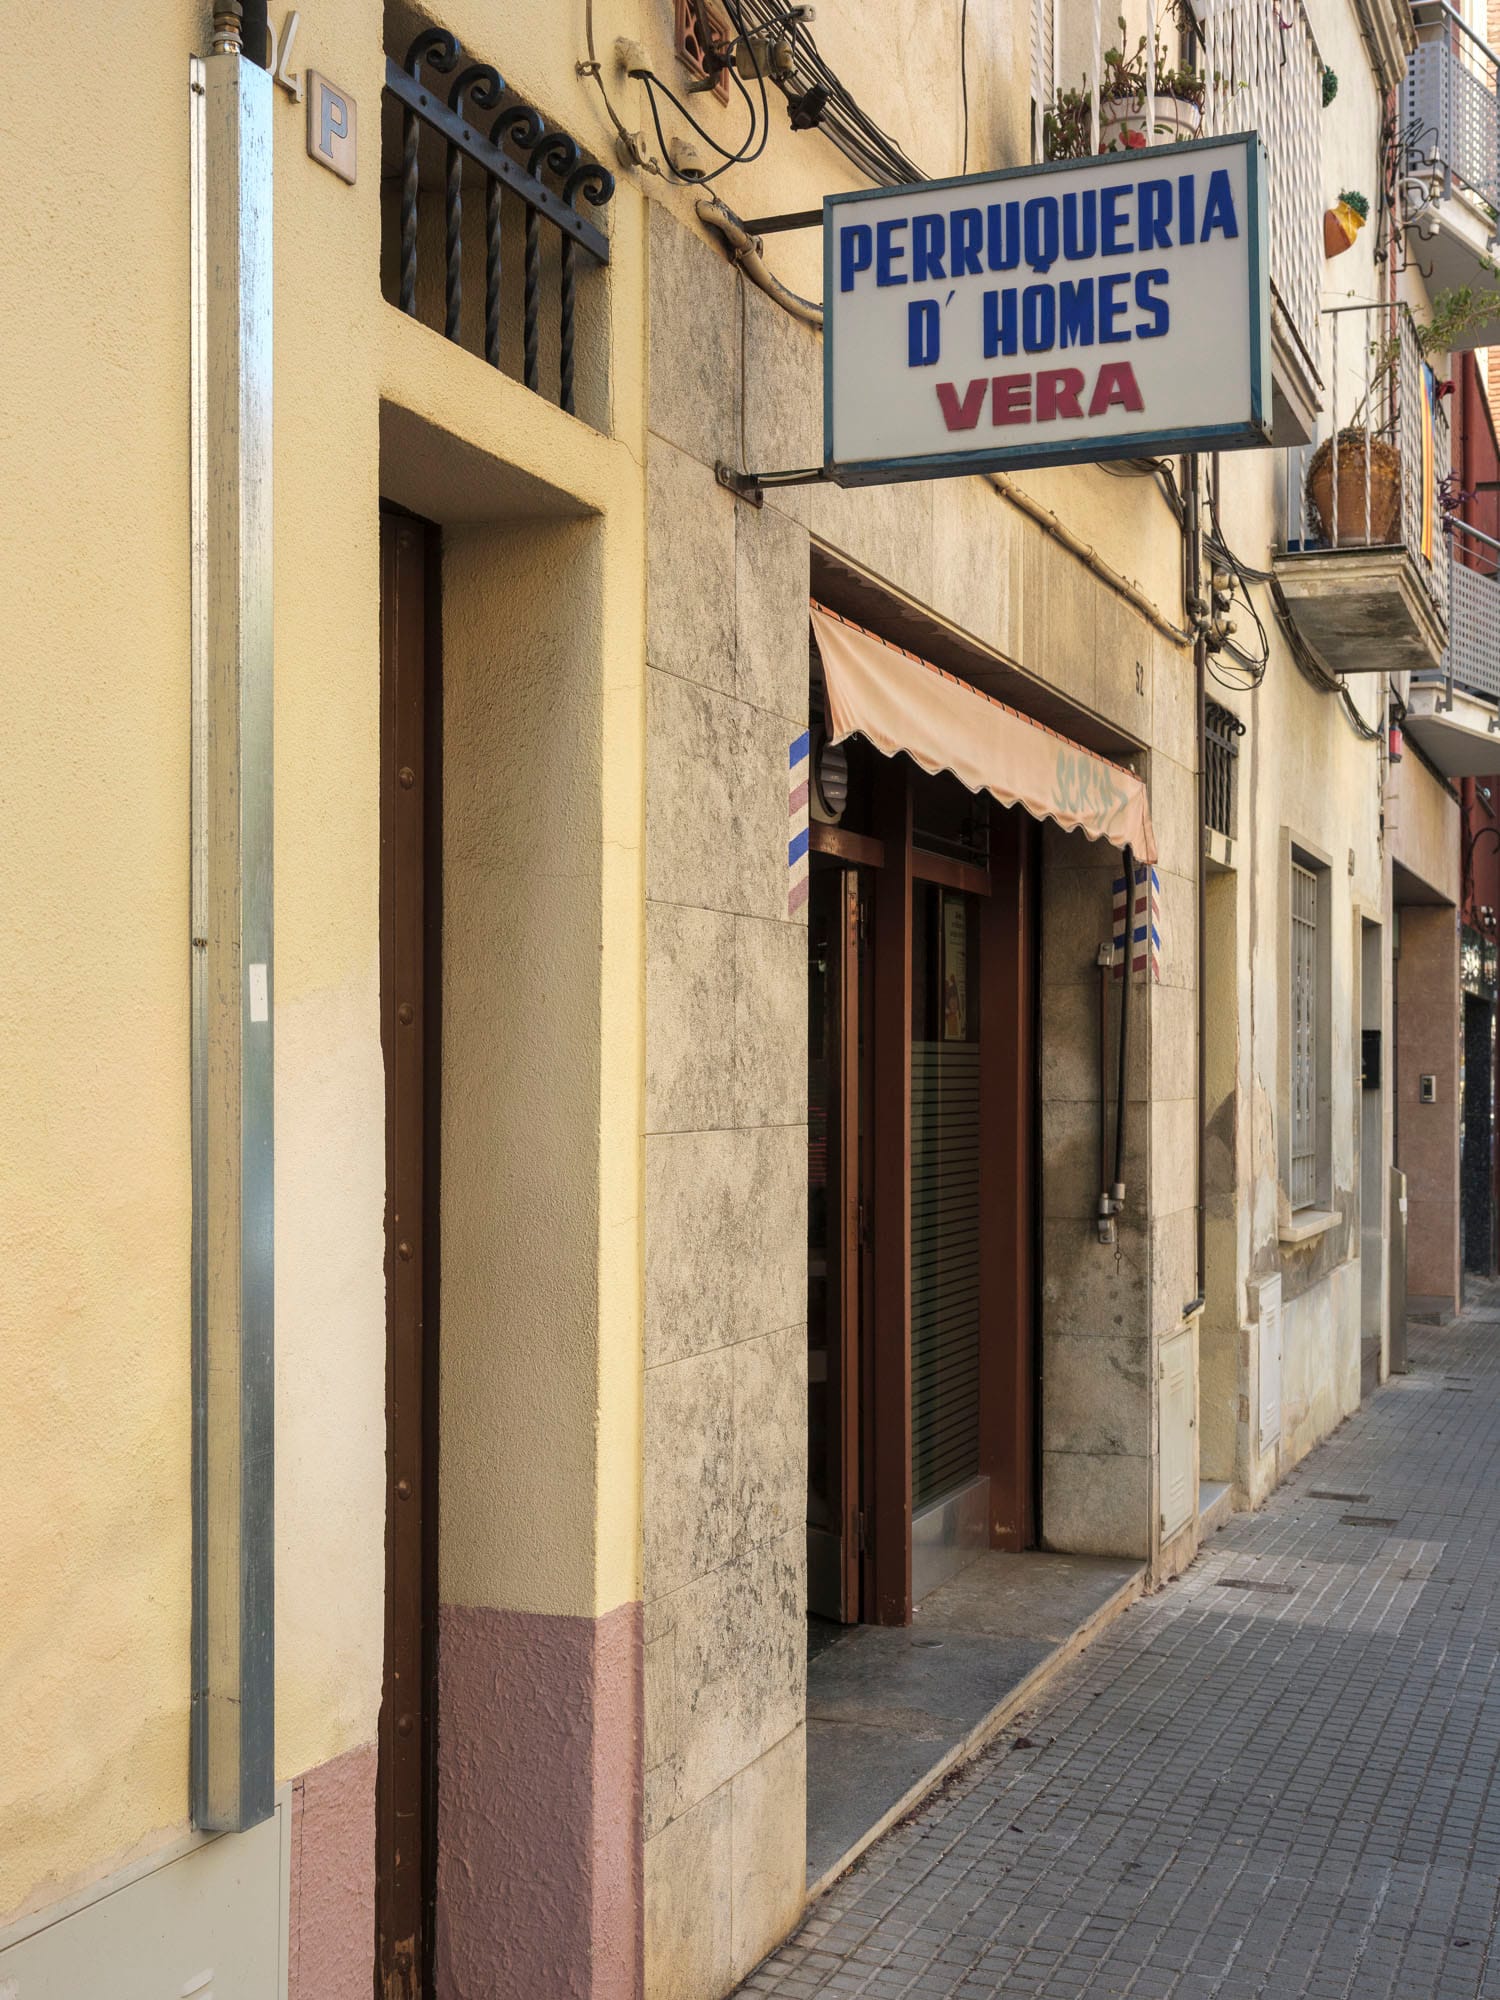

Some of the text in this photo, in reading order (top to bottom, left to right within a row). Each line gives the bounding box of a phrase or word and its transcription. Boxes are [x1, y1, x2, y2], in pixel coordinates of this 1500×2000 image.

[319, 83, 348, 158] P
[840, 169, 1239, 292] PERRUQUERIA
[983, 268, 1169, 358] HOMES
[935, 361, 1144, 431] VERA
